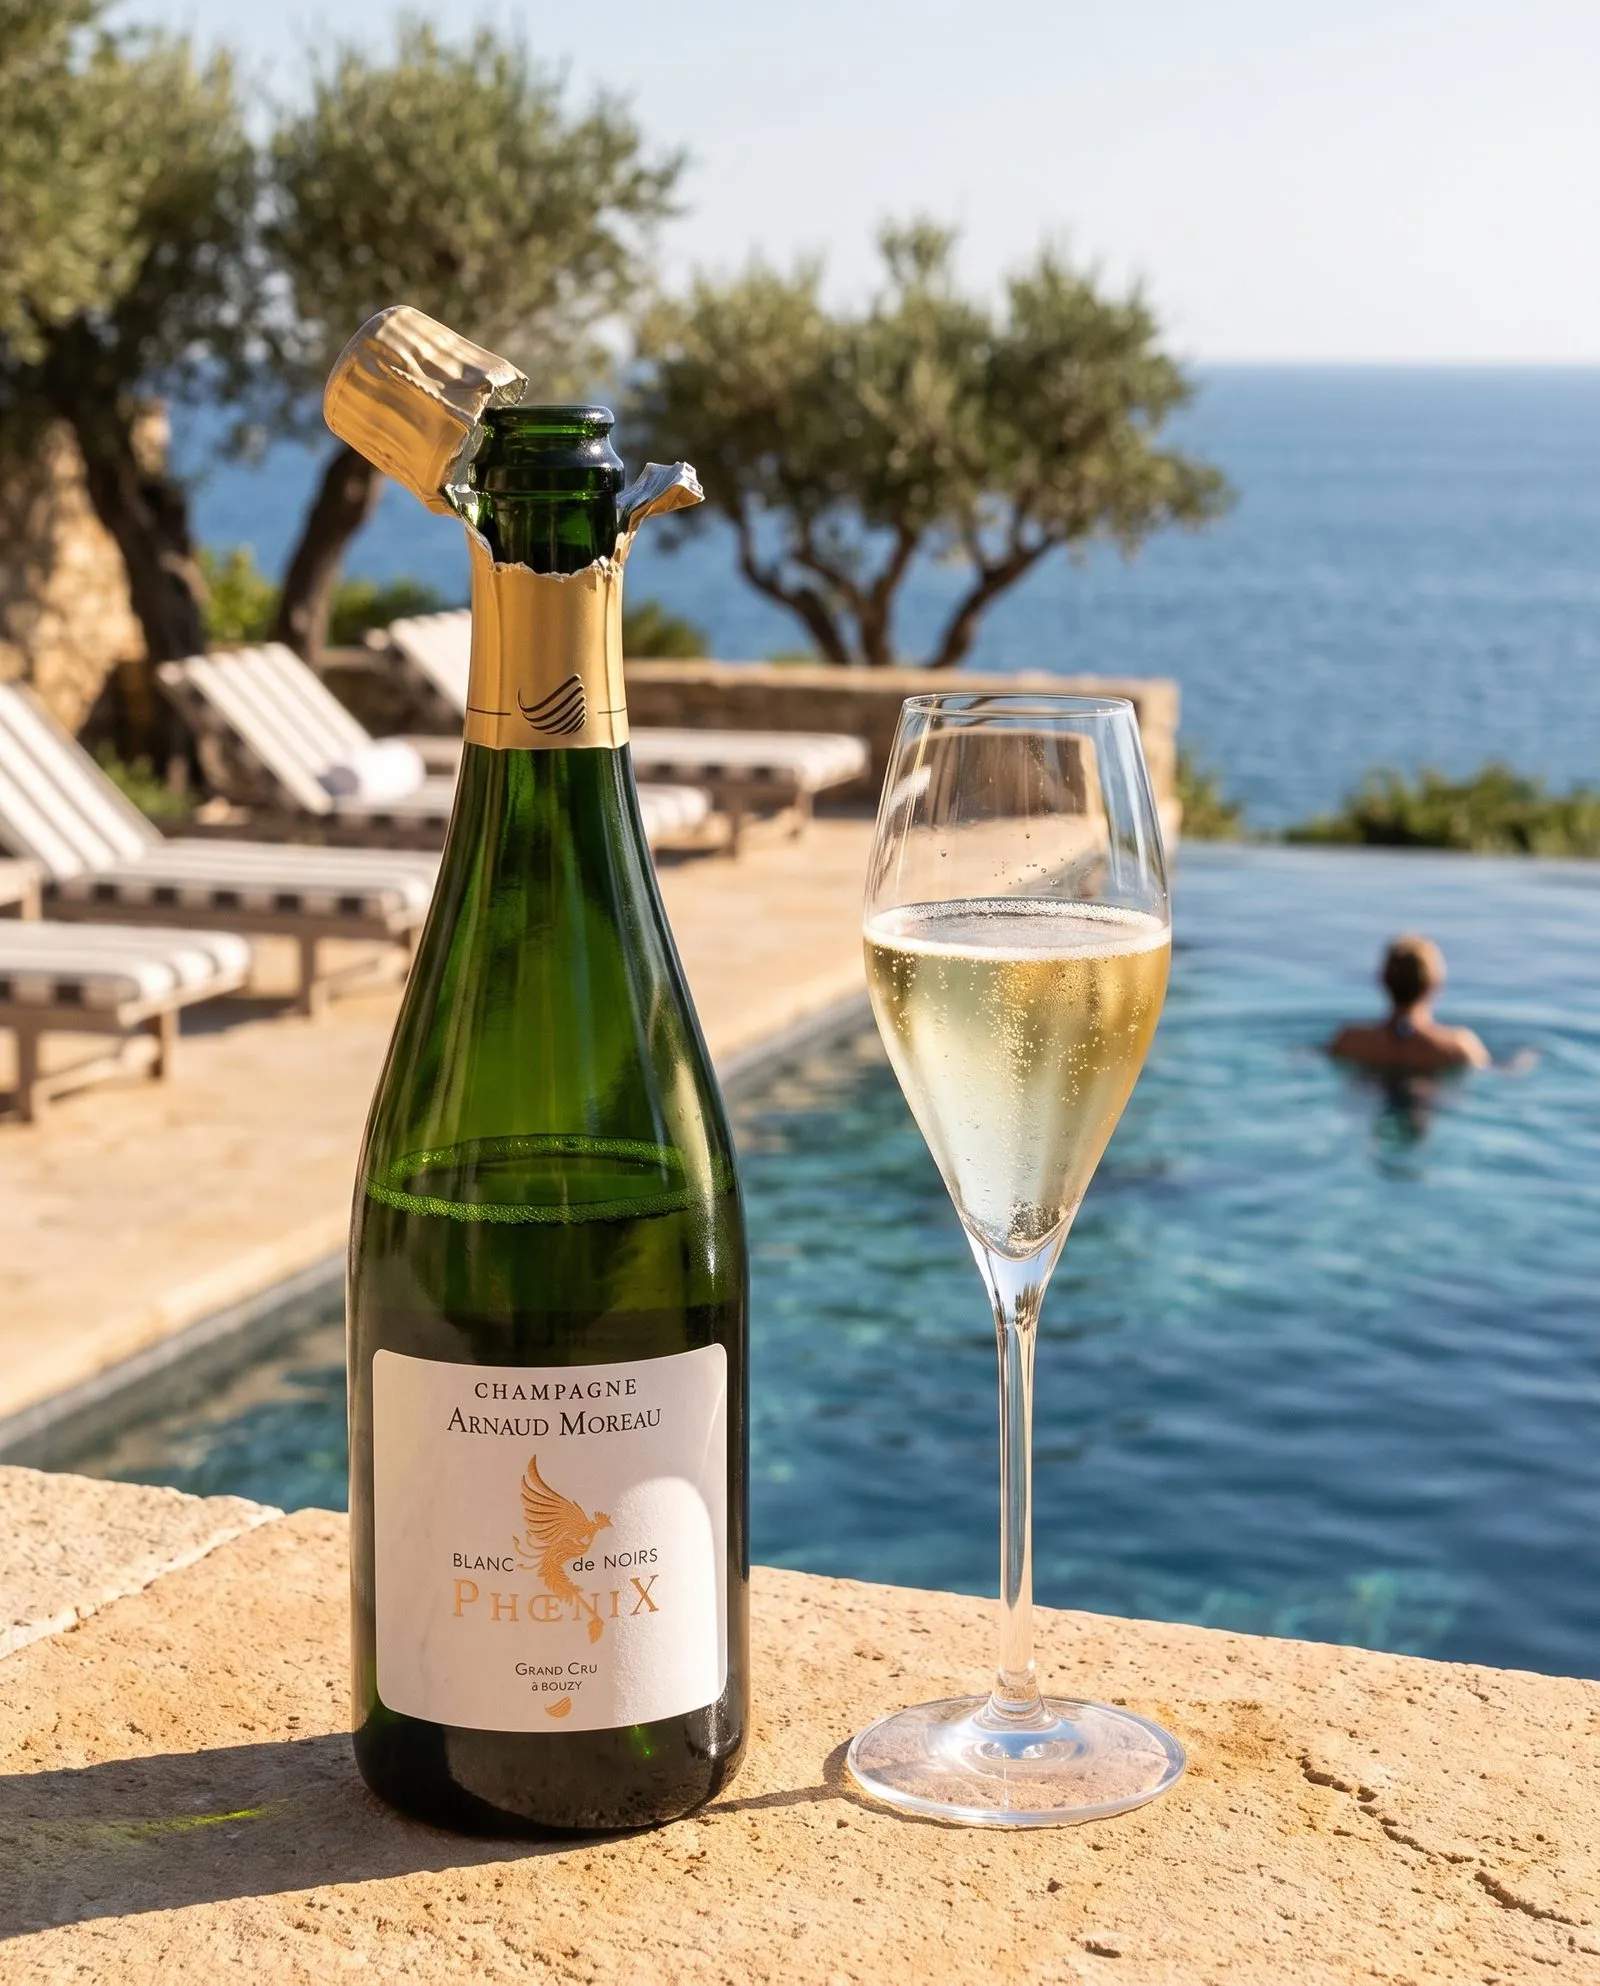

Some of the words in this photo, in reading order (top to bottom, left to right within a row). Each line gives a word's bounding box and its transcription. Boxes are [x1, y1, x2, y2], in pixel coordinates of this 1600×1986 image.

[474, 1378, 637, 1400] CHAMPAGNE
[446, 1406, 549, 1437] ARNAUD
[559, 1408, 661, 1436] MOREAU
[453, 1552, 514, 1572] BLANC
[572, 1557, 595, 1571] de
[604, 1548, 658, 1569] NOIRS
[515, 1662, 563, 1676] GRAND
[567, 1661, 598, 1675] CRU
[541, 1680, 582, 1692] BOUZY
